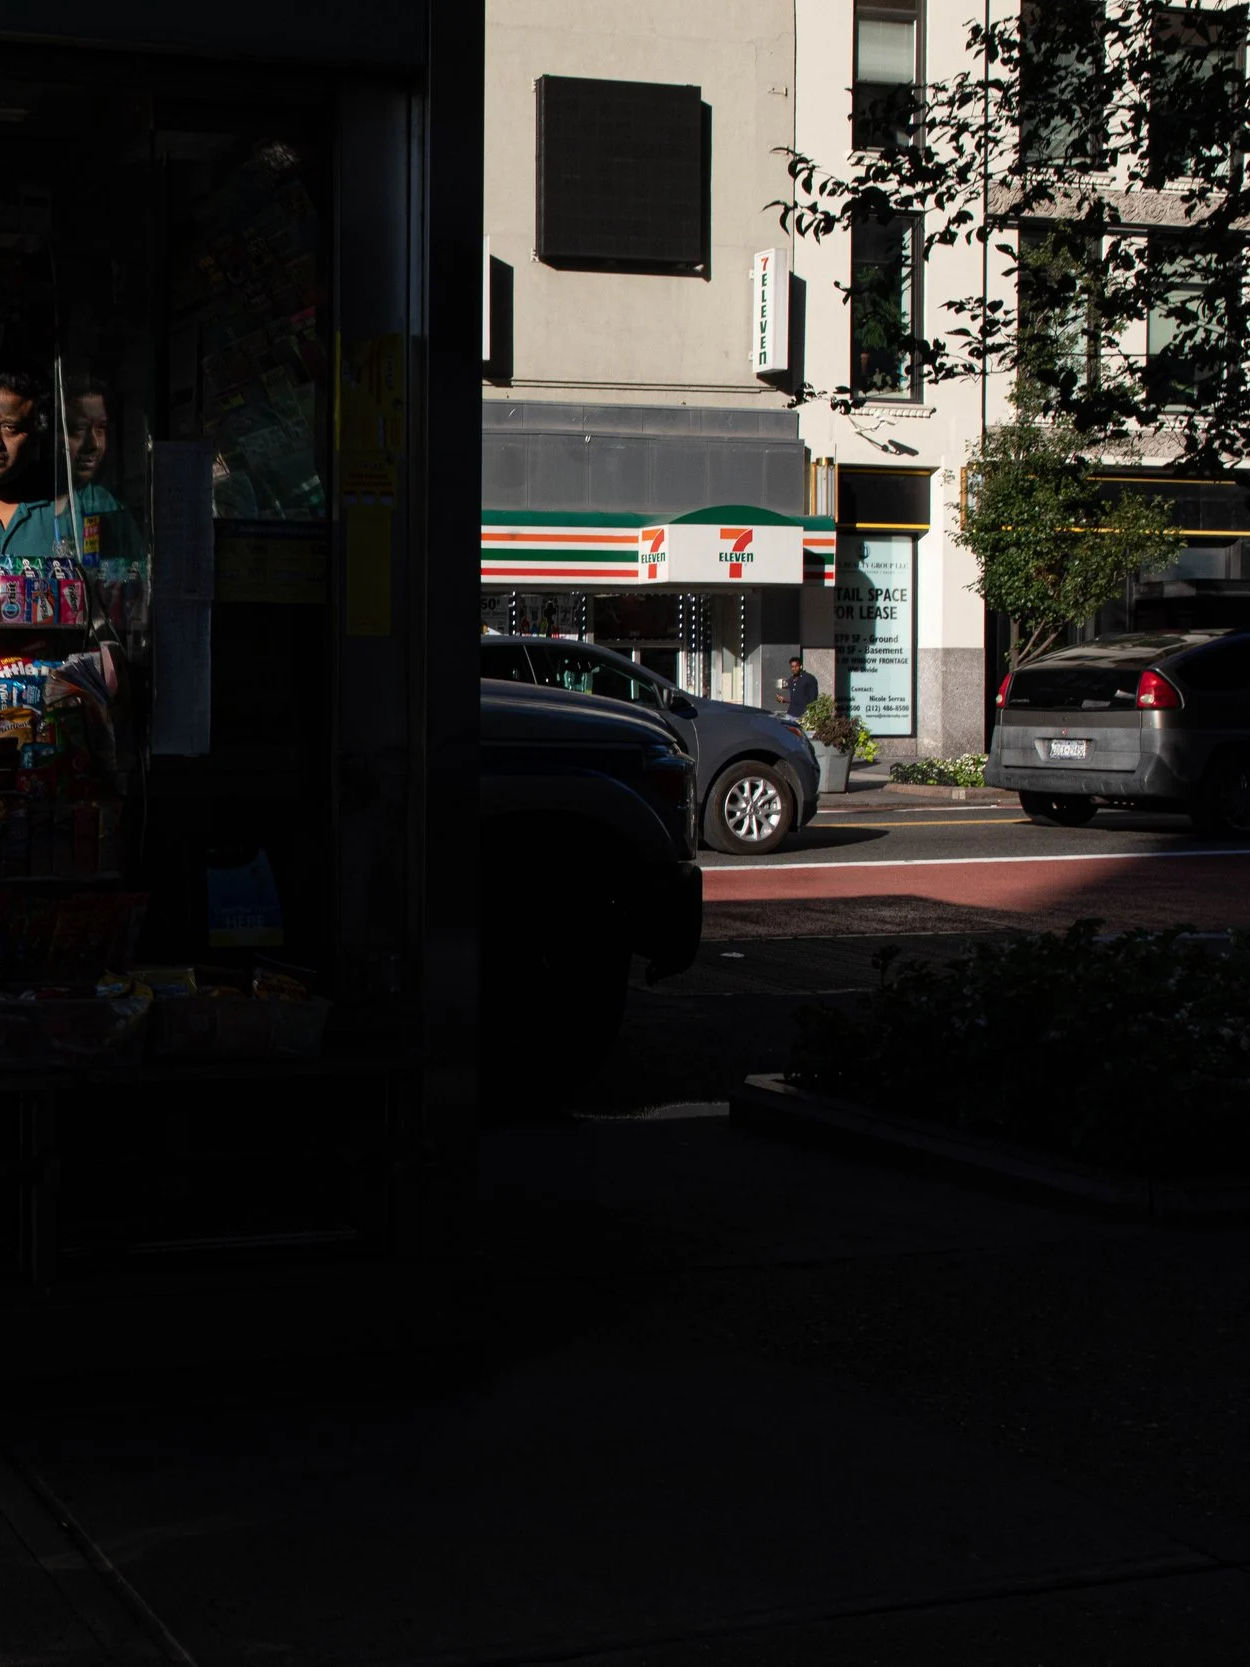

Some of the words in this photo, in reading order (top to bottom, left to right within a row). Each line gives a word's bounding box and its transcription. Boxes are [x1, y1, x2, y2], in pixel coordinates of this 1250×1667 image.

[835, 587, 863, 601] TAIL
[868, 587, 908, 602] SPACE
[834, 606, 854, 620] OR
[859, 605, 898, 620] LEASE
[870, 634, 899, 643] Ground
[865, 646, 903, 654] Basement
